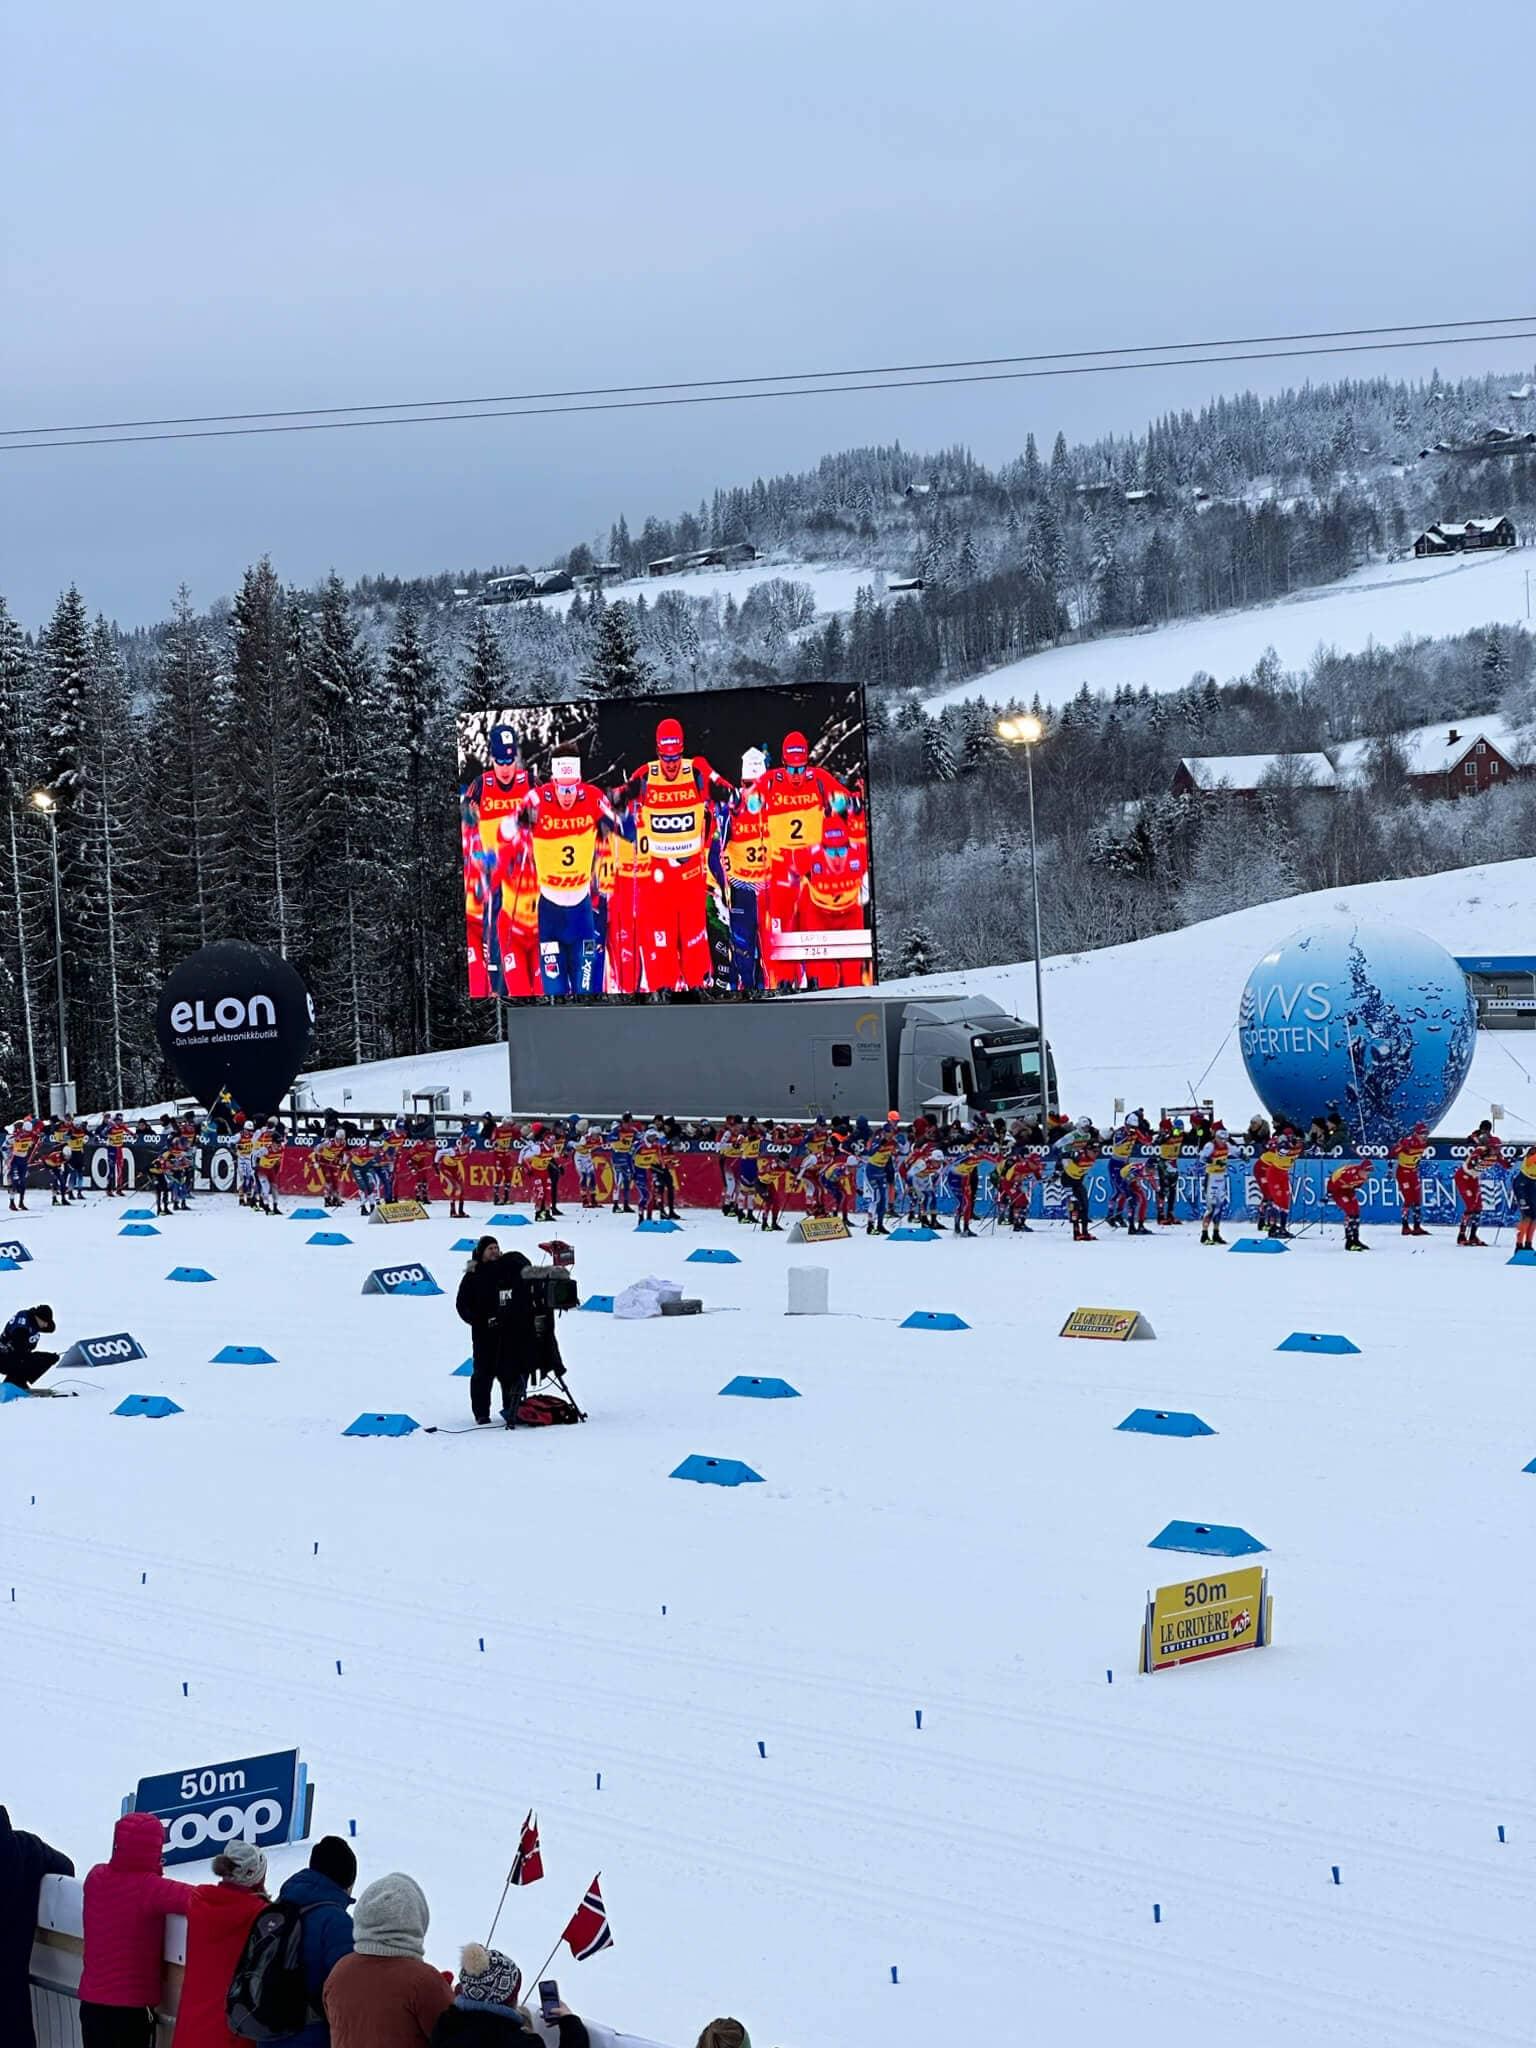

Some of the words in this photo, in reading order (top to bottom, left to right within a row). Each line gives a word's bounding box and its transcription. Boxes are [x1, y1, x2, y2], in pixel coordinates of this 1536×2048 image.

[494, 796, 525, 812] EXTR
[652, 815, 694, 831] coop
[789, 819, 804, 840] 2
[561, 845, 575, 867] 3
[746, 846, 768, 863] 32
[546, 873, 589, 888] DHL
[1257, 981, 1332, 1023] VVS
[143, 1134, 161, 1145] coop
[294, 1136, 314, 1148] coop
[1356, 1144, 1389, 1159] coop
[382, 1267, 424, 1286] coop
[87, 1338, 132, 1358] coop
[1184, 1582, 1227, 1607] 50m
[1160, 1622, 1175, 1644] LE
[1176, 1610, 1230, 1640] GRUYÈRE
[1162, 1632, 1228, 1654] SWITZERLAND
[180, 1770, 246, 1800] 50m
